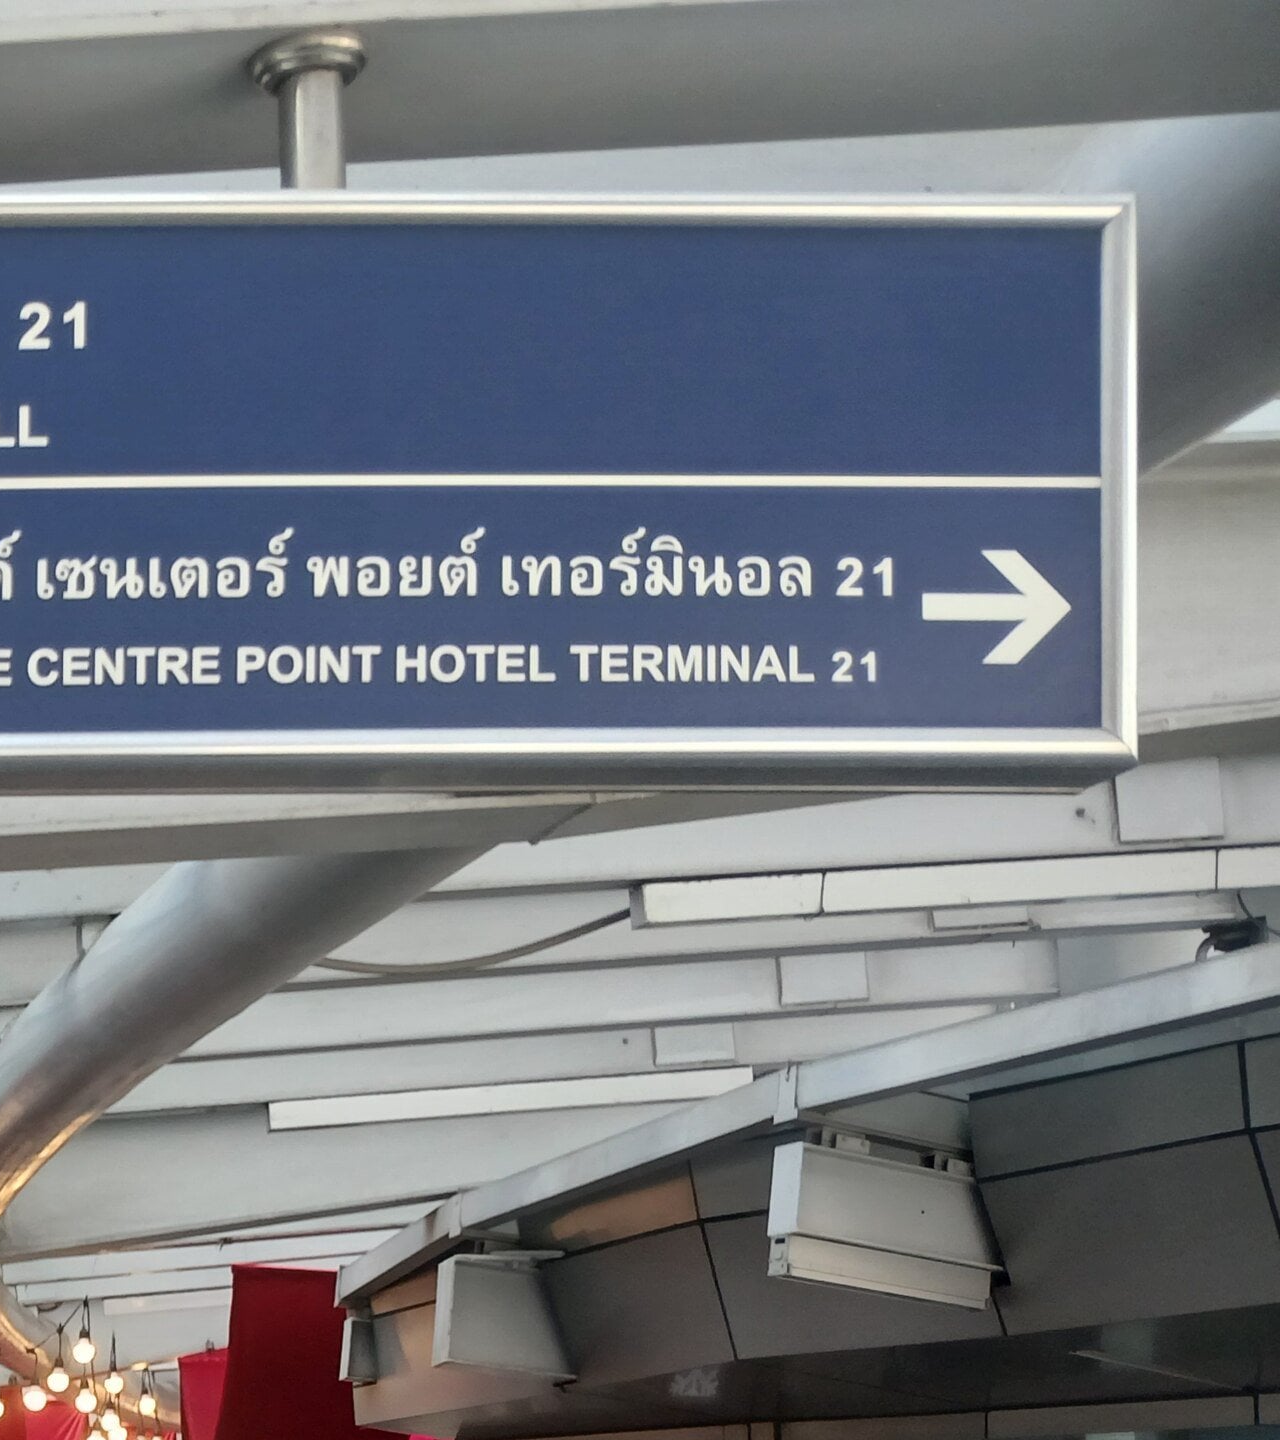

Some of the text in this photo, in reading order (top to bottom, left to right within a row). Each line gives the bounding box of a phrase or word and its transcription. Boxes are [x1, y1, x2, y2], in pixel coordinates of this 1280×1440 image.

[17, 301, 88, 350] 21
[36, 527, 294, 600] เซนเตอร์
[306, 526, 486, 599] พอยต์
[501, 526, 814, 597] เทอร์มินอล
[836, 556, 895, 597] 21
[27, 645, 222, 687] CENTRE
[236, 644, 382, 685] POINT
[395, 644, 557, 683] HOTEL
[569, 644, 816, 683] TERMINAL
[830, 650, 878, 682] 21
